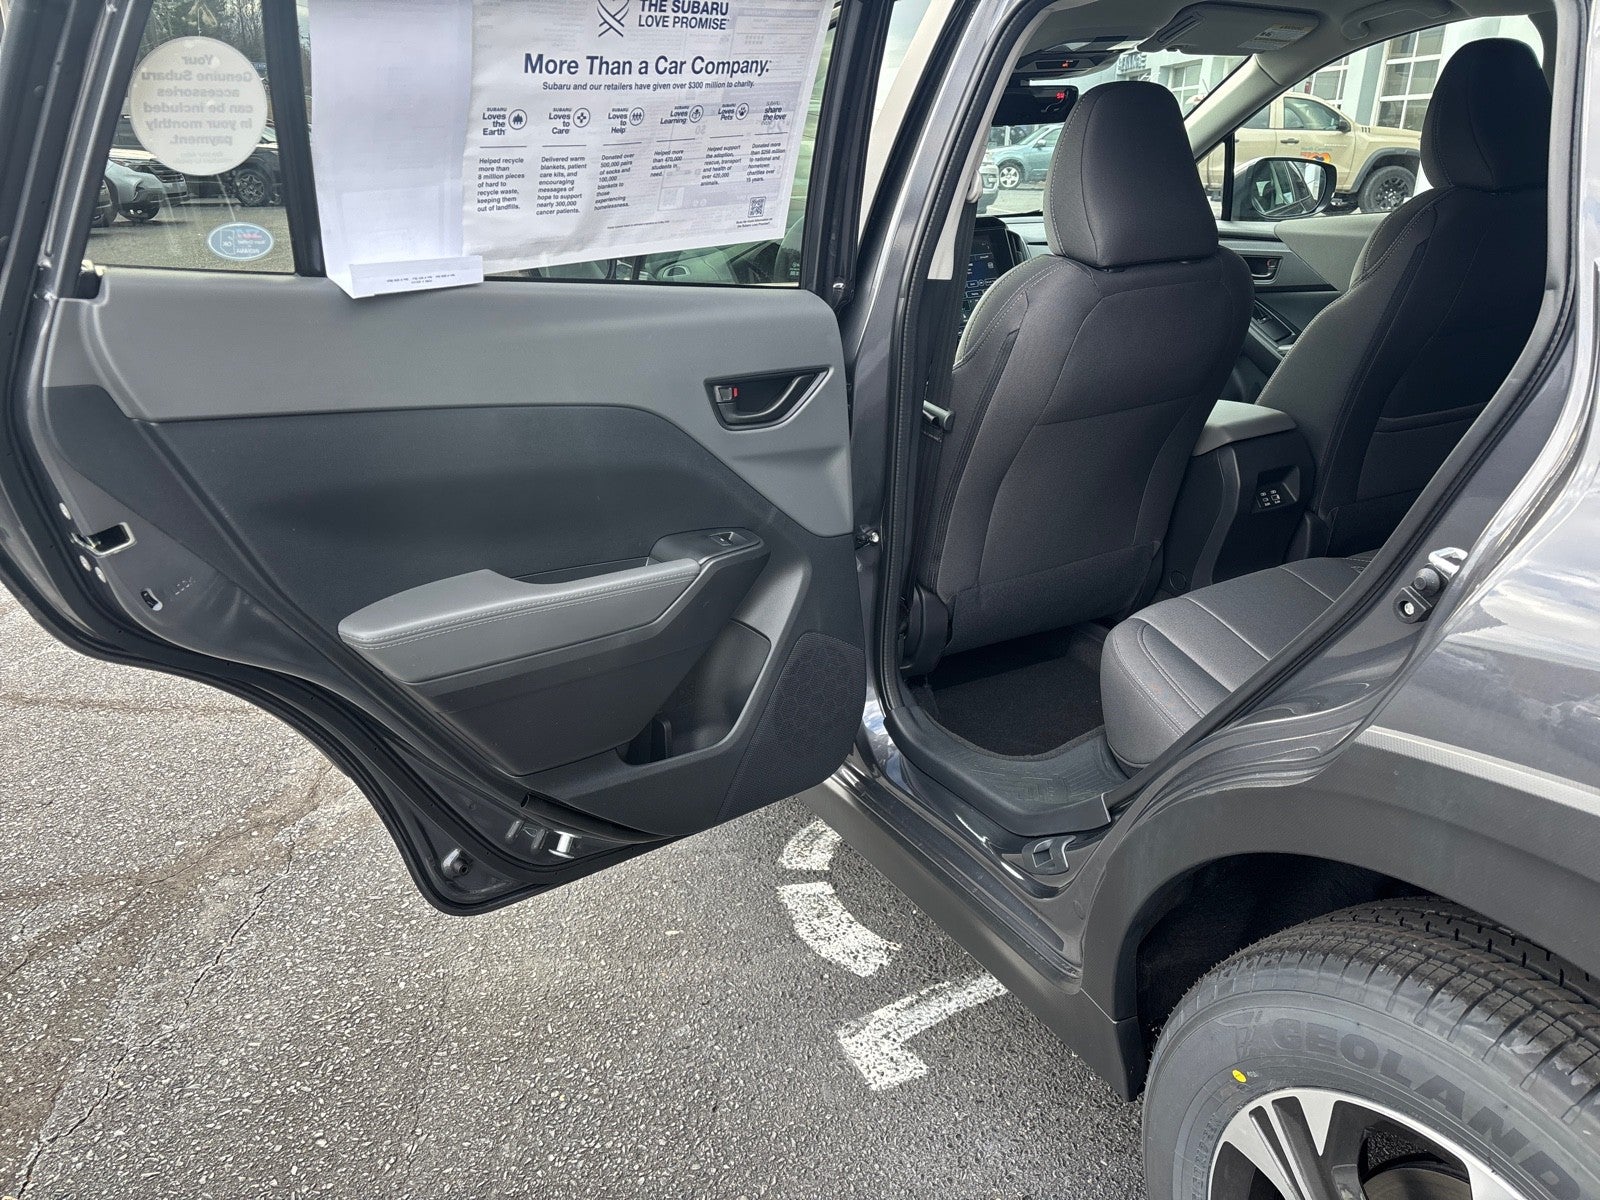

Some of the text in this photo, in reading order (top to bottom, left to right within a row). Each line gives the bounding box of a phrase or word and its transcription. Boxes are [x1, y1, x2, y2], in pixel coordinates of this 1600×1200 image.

[641, 0, 729, 15] THE SUBARU
[638, 15, 726, 30] LOVE PROMISE
[524, 53, 579, 74] More
[586, 56, 632, 75] Than
[638, 60, 648, 74] a
[655, 55, 686, 74] Car
[542, 82, 570, 90] Subaru
[573, 82, 587, 90] and
[604, 82, 632, 90] retailers
[634, 82, 651, 90] have
[652, 82, 671, 91] given
